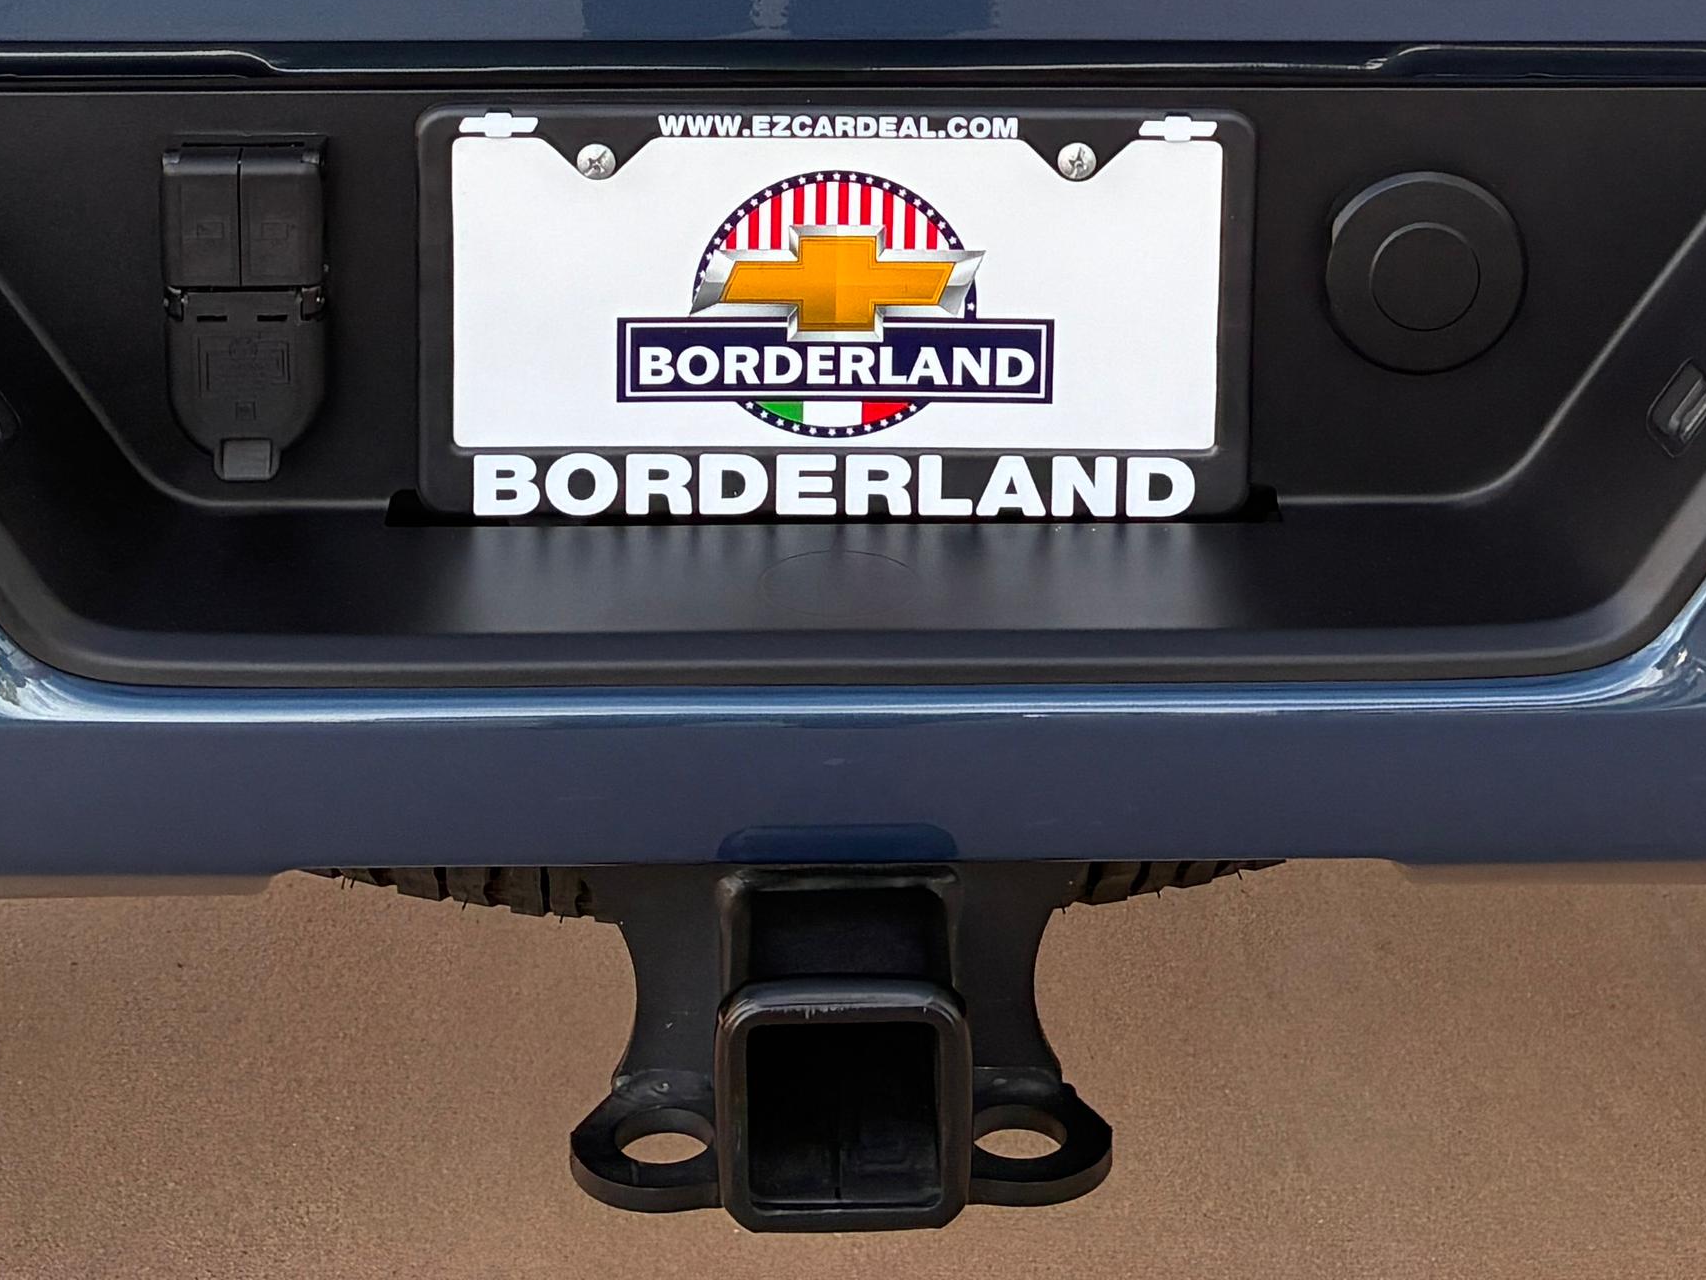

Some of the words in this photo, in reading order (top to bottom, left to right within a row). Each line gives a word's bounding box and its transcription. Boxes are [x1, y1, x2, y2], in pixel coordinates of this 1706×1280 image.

[657, 113, 1020, 140] WWW.EZCARDEAL.COM
[637, 345, 1036, 388] BORDERLAND
[471, 452, 1197, 518] BORDERLAND
